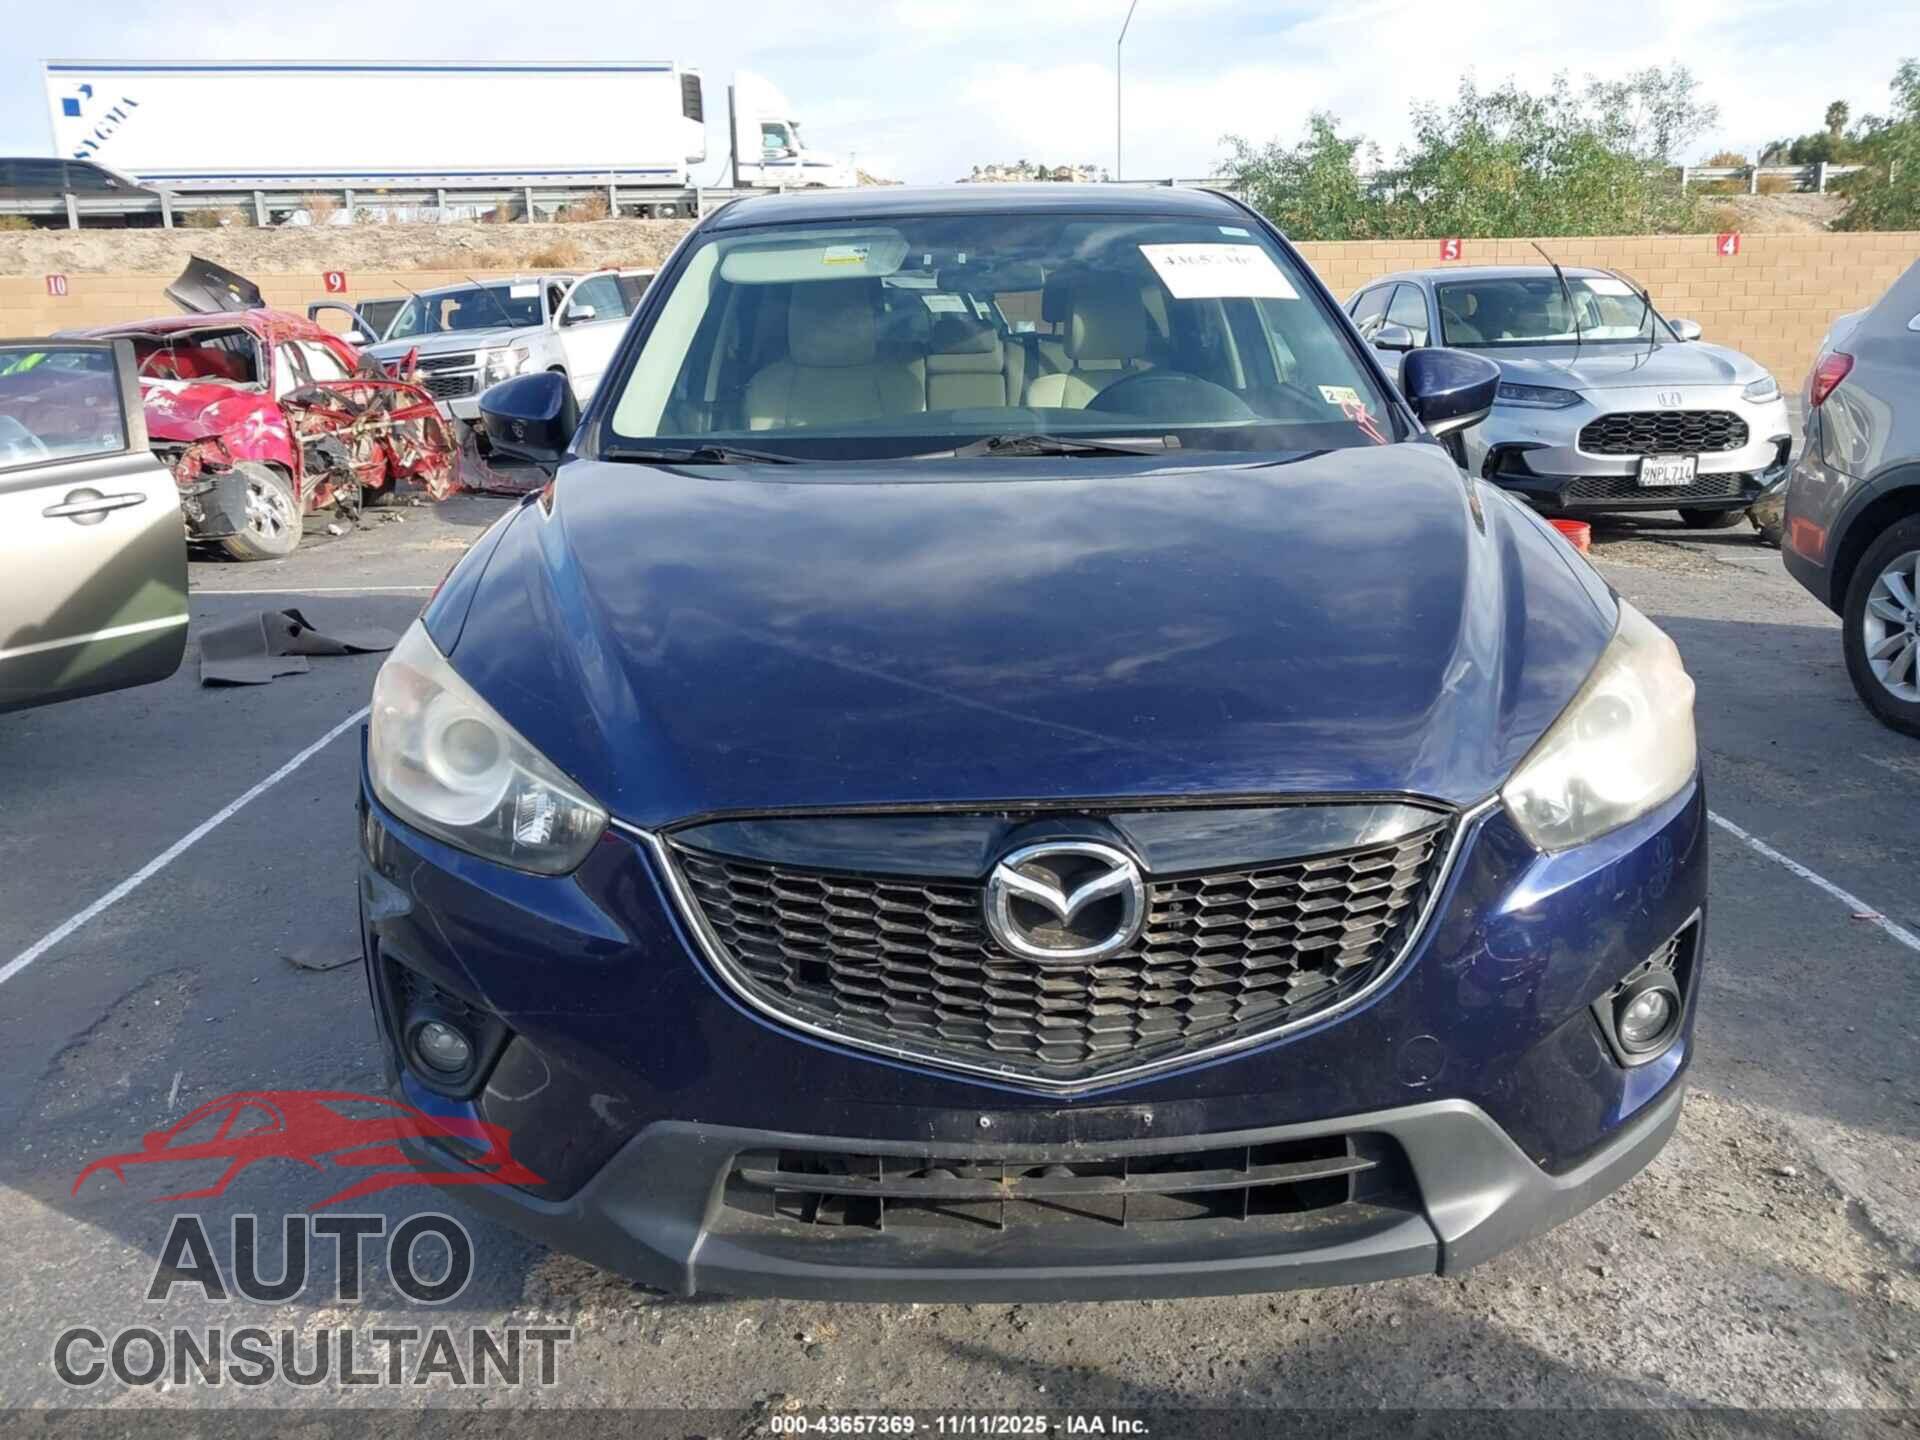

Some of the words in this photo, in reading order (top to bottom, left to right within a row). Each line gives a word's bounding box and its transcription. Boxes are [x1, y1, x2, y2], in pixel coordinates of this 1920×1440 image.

[73, 97, 139, 159] SYGMA
[1446, 239, 1458, 260] 5
[1722, 233, 1736, 256] 4
[50, 277, 65, 294] 10
[329, 273, 341, 291] 9
[1644, 466, 1692, 480] 9NPL714
